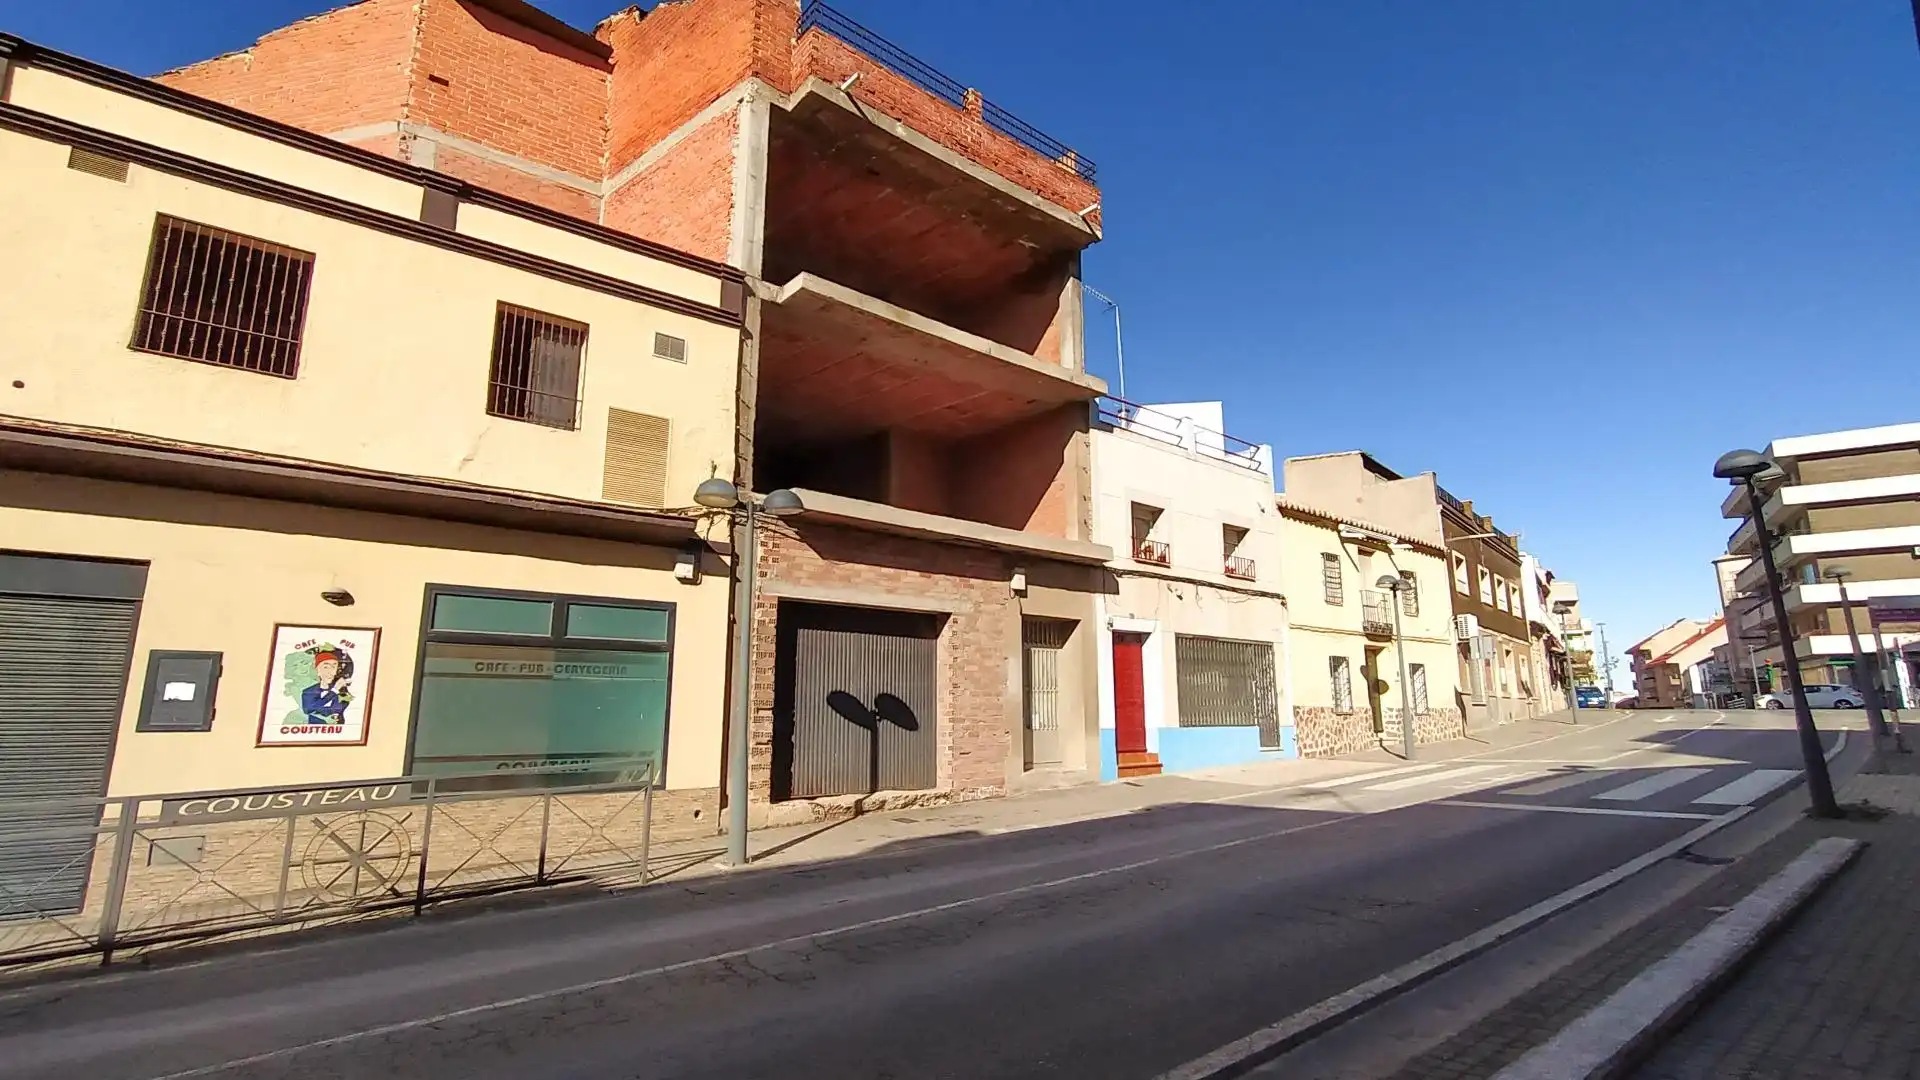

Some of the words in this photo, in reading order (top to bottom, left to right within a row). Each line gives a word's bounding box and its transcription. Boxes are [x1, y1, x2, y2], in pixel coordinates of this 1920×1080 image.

[519, 663, 544, 673] PUB
[280, 726, 343, 734] COUSTEAU
[178, 785, 397, 816] COUSTEAU
